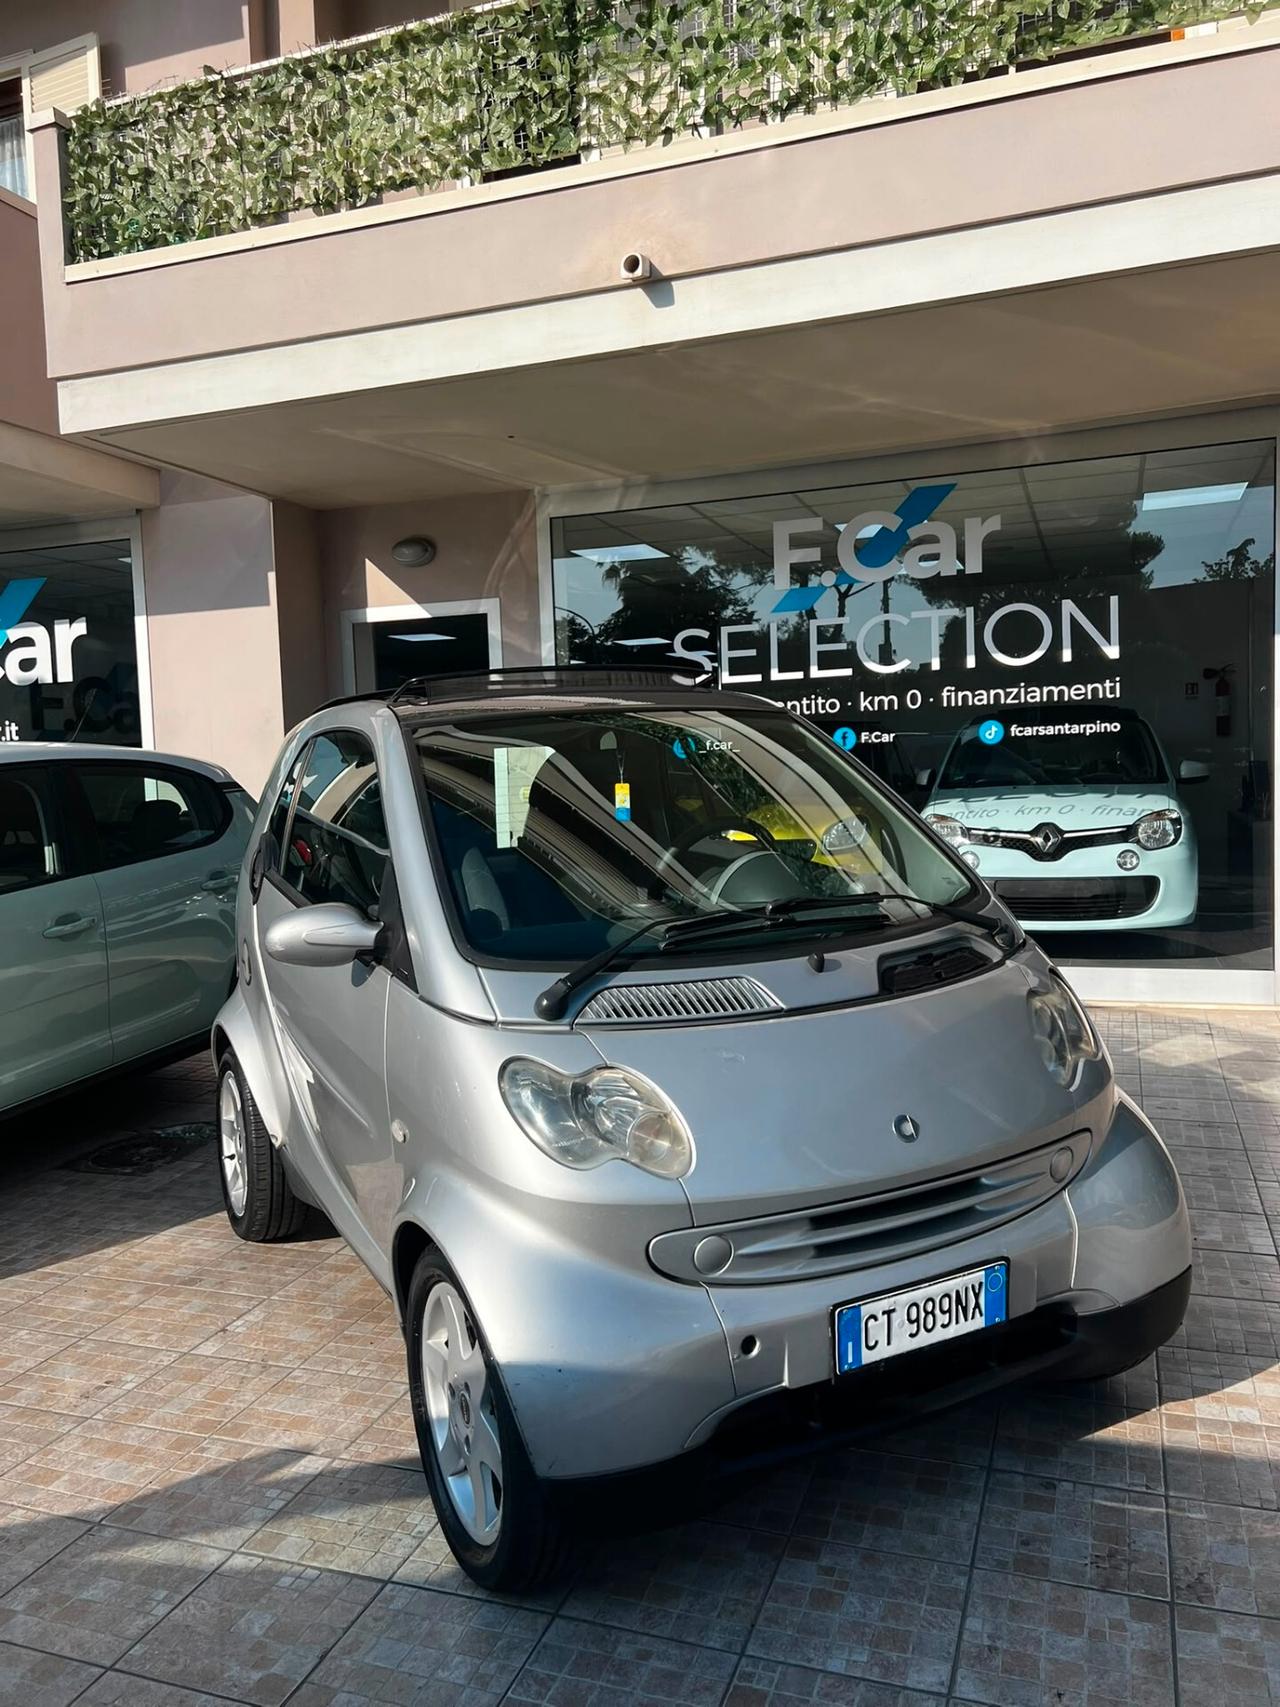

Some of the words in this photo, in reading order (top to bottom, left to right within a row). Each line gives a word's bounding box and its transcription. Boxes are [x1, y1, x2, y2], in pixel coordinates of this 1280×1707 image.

[773, 510, 1002, 591] F.Car
[0, 616, 88, 686] ar
[671, 595, 1120, 687] SELECTION
[777, 694, 841, 716] ntito
[860, 690, 899, 712] km
[906, 689, 922, 709] 0
[941, 676, 1121, 708] finanziamenti
[1010, 719, 1121, 737] fcarsantarpino
[860, 730, 896, 744] F.Car
[863, 1307, 896, 1352] CT
[906, 1280, 984, 1339] 989NX
